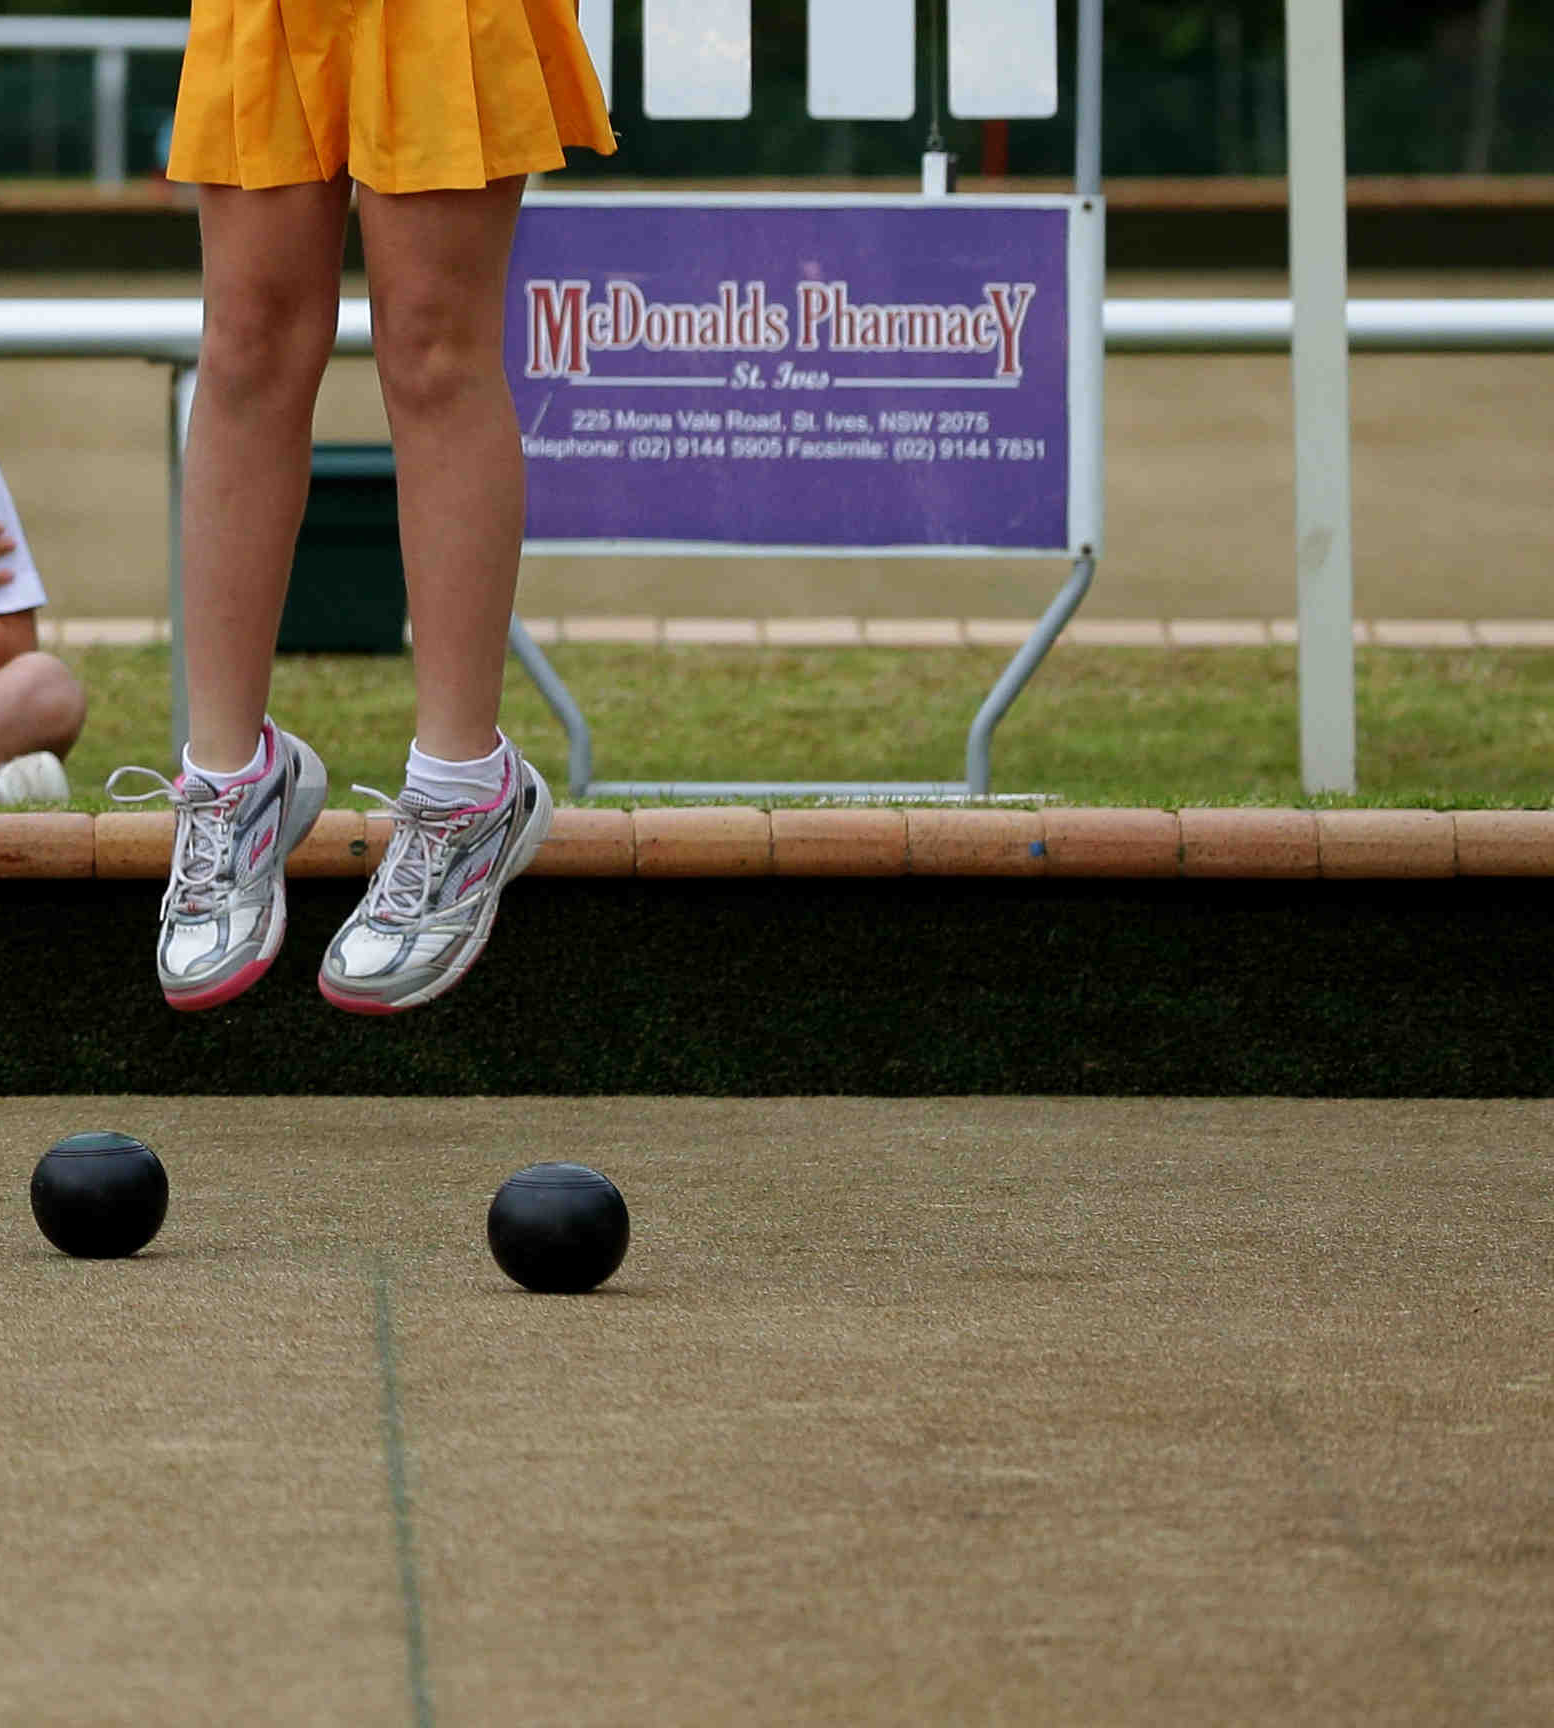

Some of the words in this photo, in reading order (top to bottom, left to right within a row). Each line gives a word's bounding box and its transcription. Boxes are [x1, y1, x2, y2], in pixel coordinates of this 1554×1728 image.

[525, 280, 789, 378] McDonalds
[730, 361, 765, 390] St.
[771, 361, 830, 390] Ives
[572, 409, 612, 433] 225
[614, 409, 673, 433] Mona
[675, 409, 722, 433] Vale
[878, 411, 934, 434] NSW
[937, 411, 990, 435] 2075
[627, 435, 671, 461] (02)
[674, 435, 726, 458] 9144
[787, 436, 889, 459] Facsimile:
[893, 437, 936, 463] (02)
[938, 437, 991, 460] 9144
